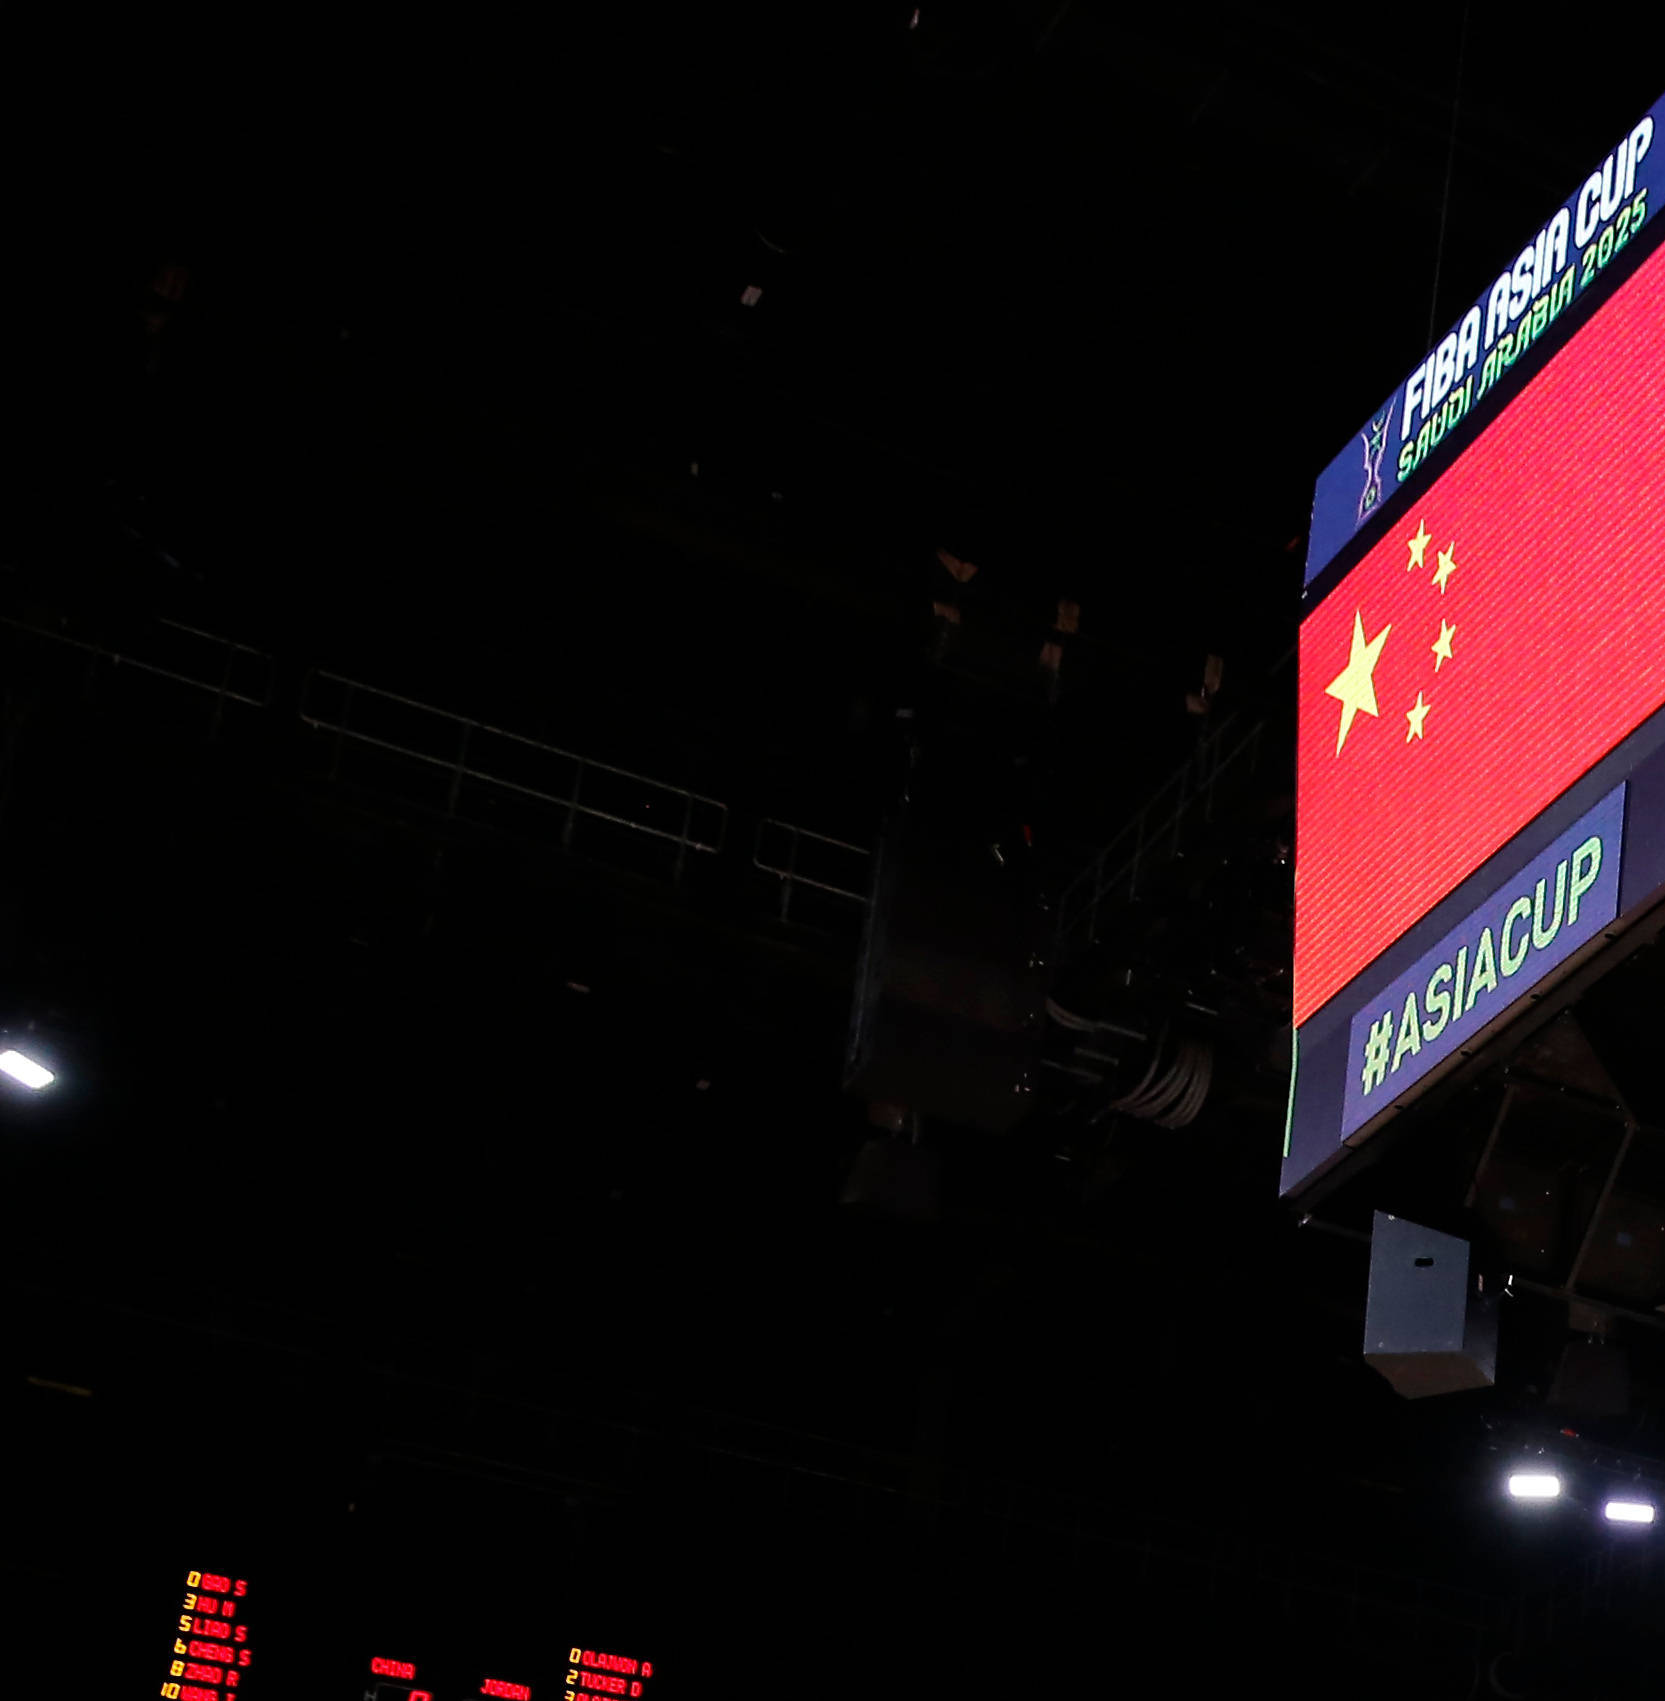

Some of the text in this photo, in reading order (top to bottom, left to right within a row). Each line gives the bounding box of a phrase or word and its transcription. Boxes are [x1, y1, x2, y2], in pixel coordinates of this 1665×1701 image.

[1400, 116, 1654, 441] FIBA ASIA CUP
[1397, 187, 1649, 482] SAUDI ARABIA 2025
[1361, 836, 1603, 1096] #ASIACUP
[187, 1571, 201, 1587] 0
[183, 1593, 197, 1610] 3
[178, 1615, 192, 1631] 5
[174, 1638, 187, 1654] 6
[569, 1648, 581, 1664] 0
[170, 1660, 185, 1676] 8
[371, 1656, 416, 1681] CHINA
[566, 1669, 579, 1685] 2
[161, 1682, 180, 1699] 10
